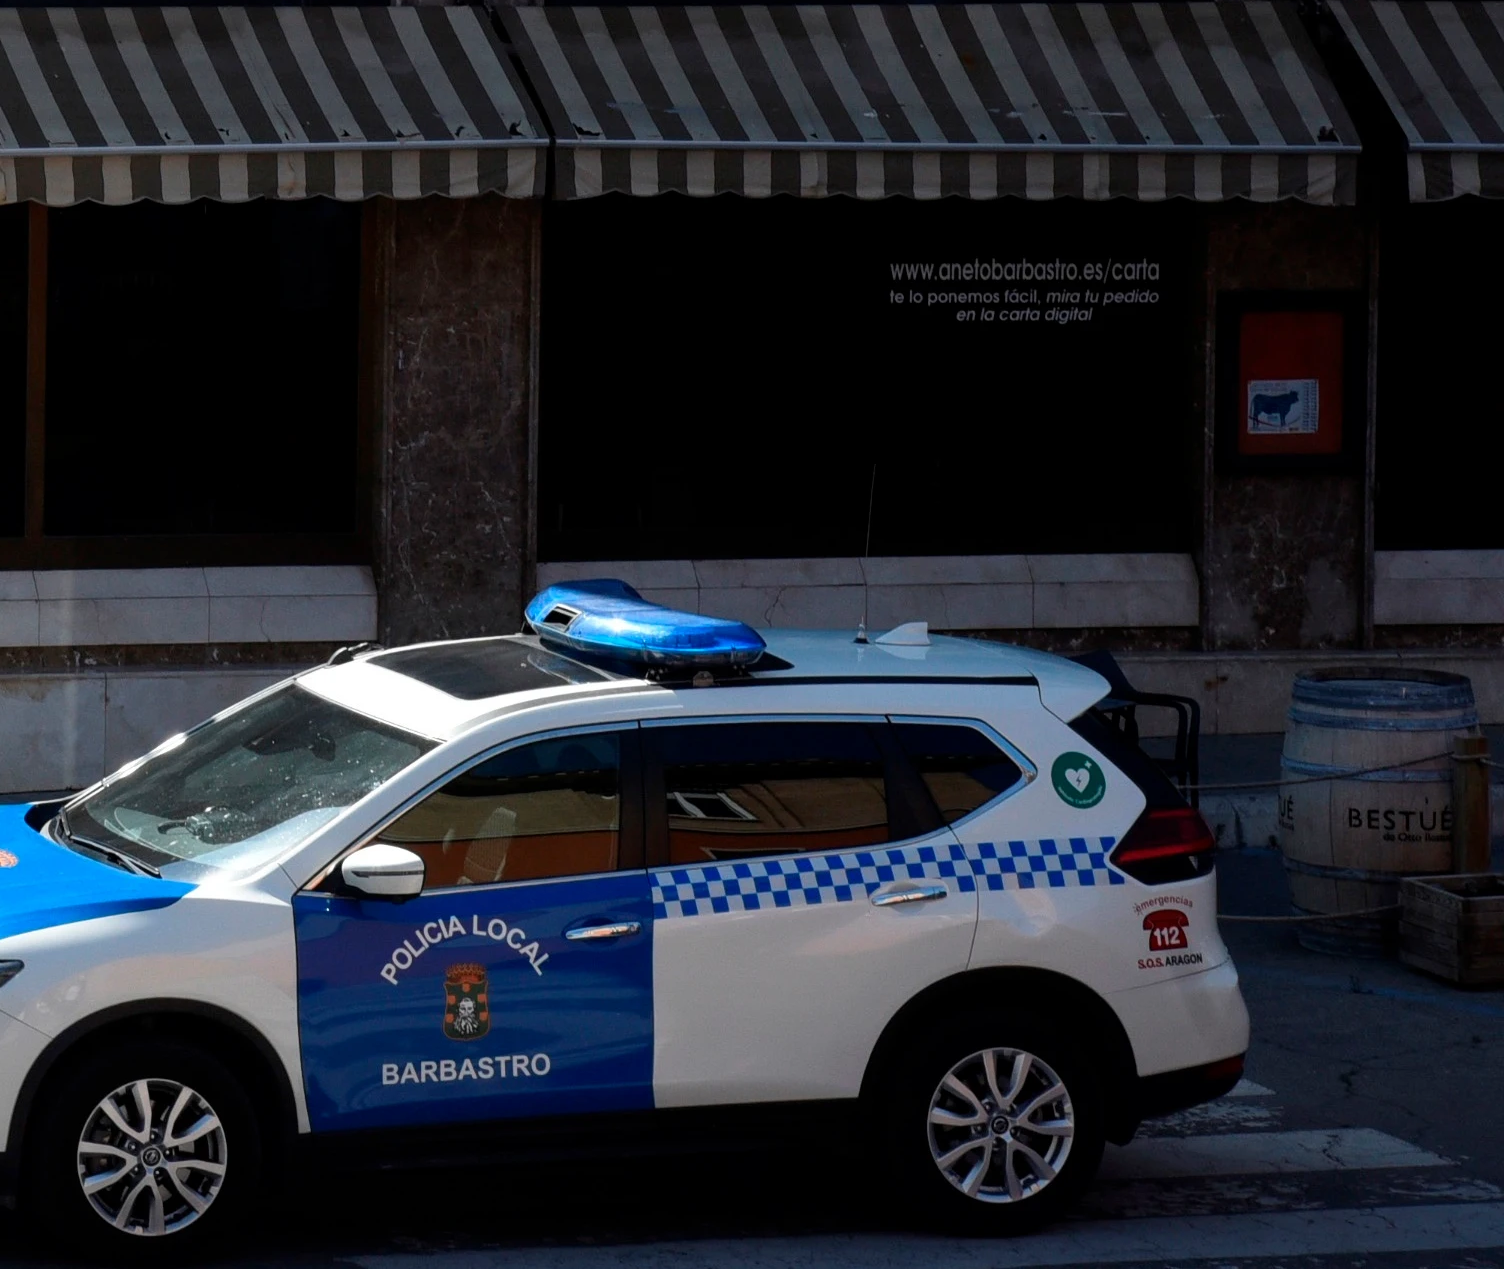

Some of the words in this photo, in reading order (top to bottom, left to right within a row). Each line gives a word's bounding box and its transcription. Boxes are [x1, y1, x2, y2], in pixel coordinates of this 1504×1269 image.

[890, 257, 1160, 285] www.anetobarbastro.es/carta
[890, 289, 904, 304] te
[909, 289, 924, 304] lo
[928, 291, 1000, 306] ponemos
[1004, 289, 1041, 306] fácil,
[1046, 290, 1080, 304] mira
[1084, 290, 1100, 304] tu
[1103, 289, 1160, 306] pedido
[956, 310, 976, 322] en
[980, 307, 996, 322] la
[998, 308, 1041, 322] carta
[1044, 307, 1093, 325] digital
[1135, 896, 1193, 913] emergencias
[1154, 926, 1180, 947] 112
[380, 914, 466, 986] POLICIA
[472, 914, 550, 976] LOCAL
[1138, 957, 1165, 969] S.O.S.
[1165, 953, 1203, 967] ARAGON
[382, 1053, 551, 1085] BARBASTRO
